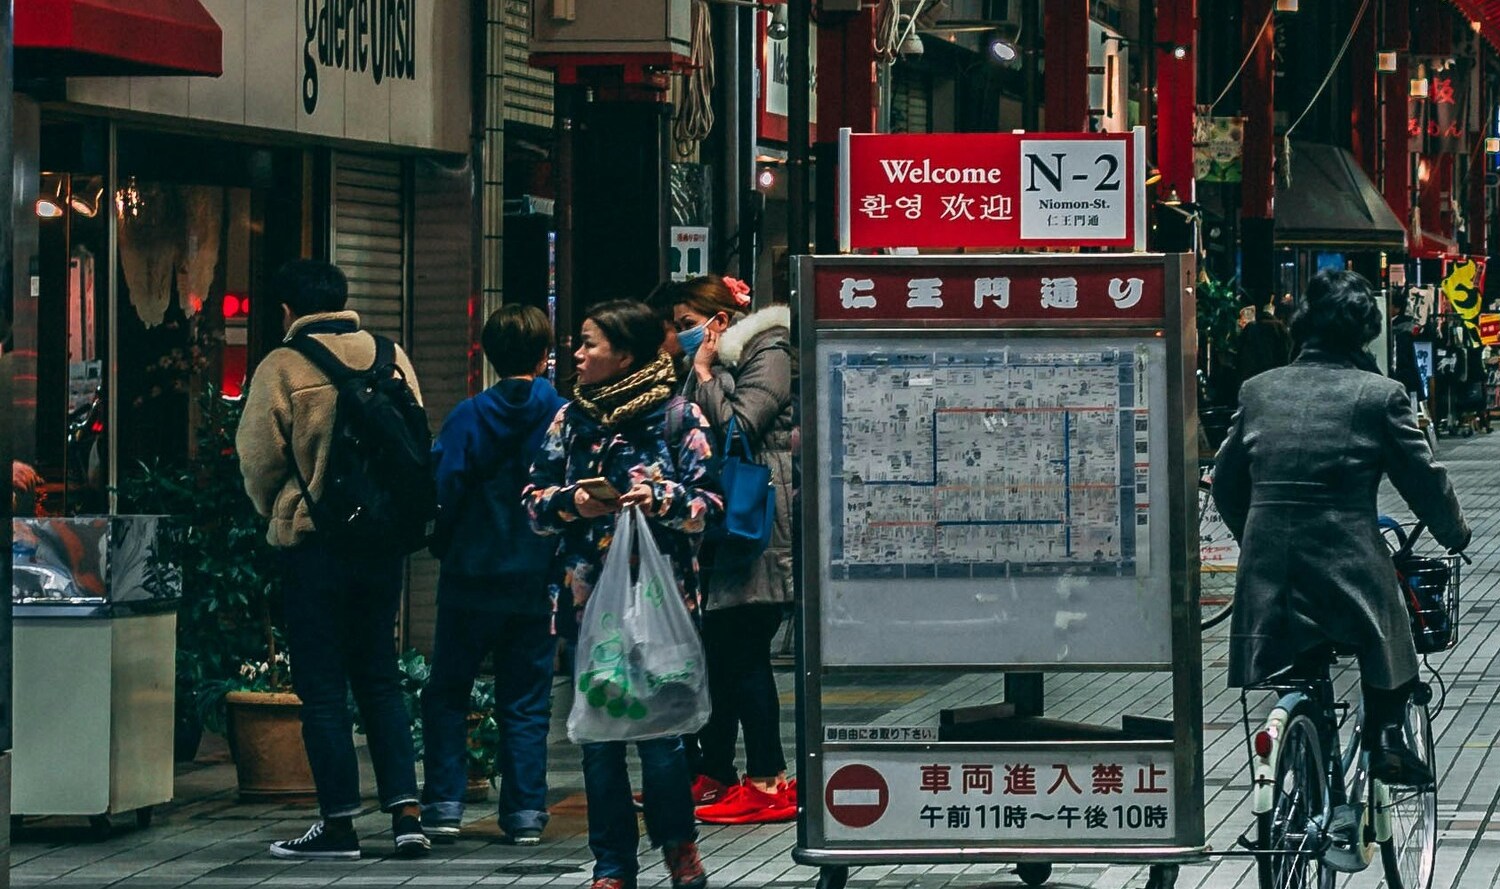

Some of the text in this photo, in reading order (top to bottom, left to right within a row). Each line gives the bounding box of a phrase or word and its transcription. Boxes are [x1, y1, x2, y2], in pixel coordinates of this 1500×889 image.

[880, 159, 1001, 184] Welcome
[1025, 153, 1120, 192] N-2
[859, 193, 1013, 221] 환영 欢迎
[1039, 199, 1110, 209] Niomon-St.
[1047, 215, 1099, 227] 仁王門通
[840, 277, 1144, 309] 仁王門通り
[919, 763, 1168, 795] 車両進入禁止
